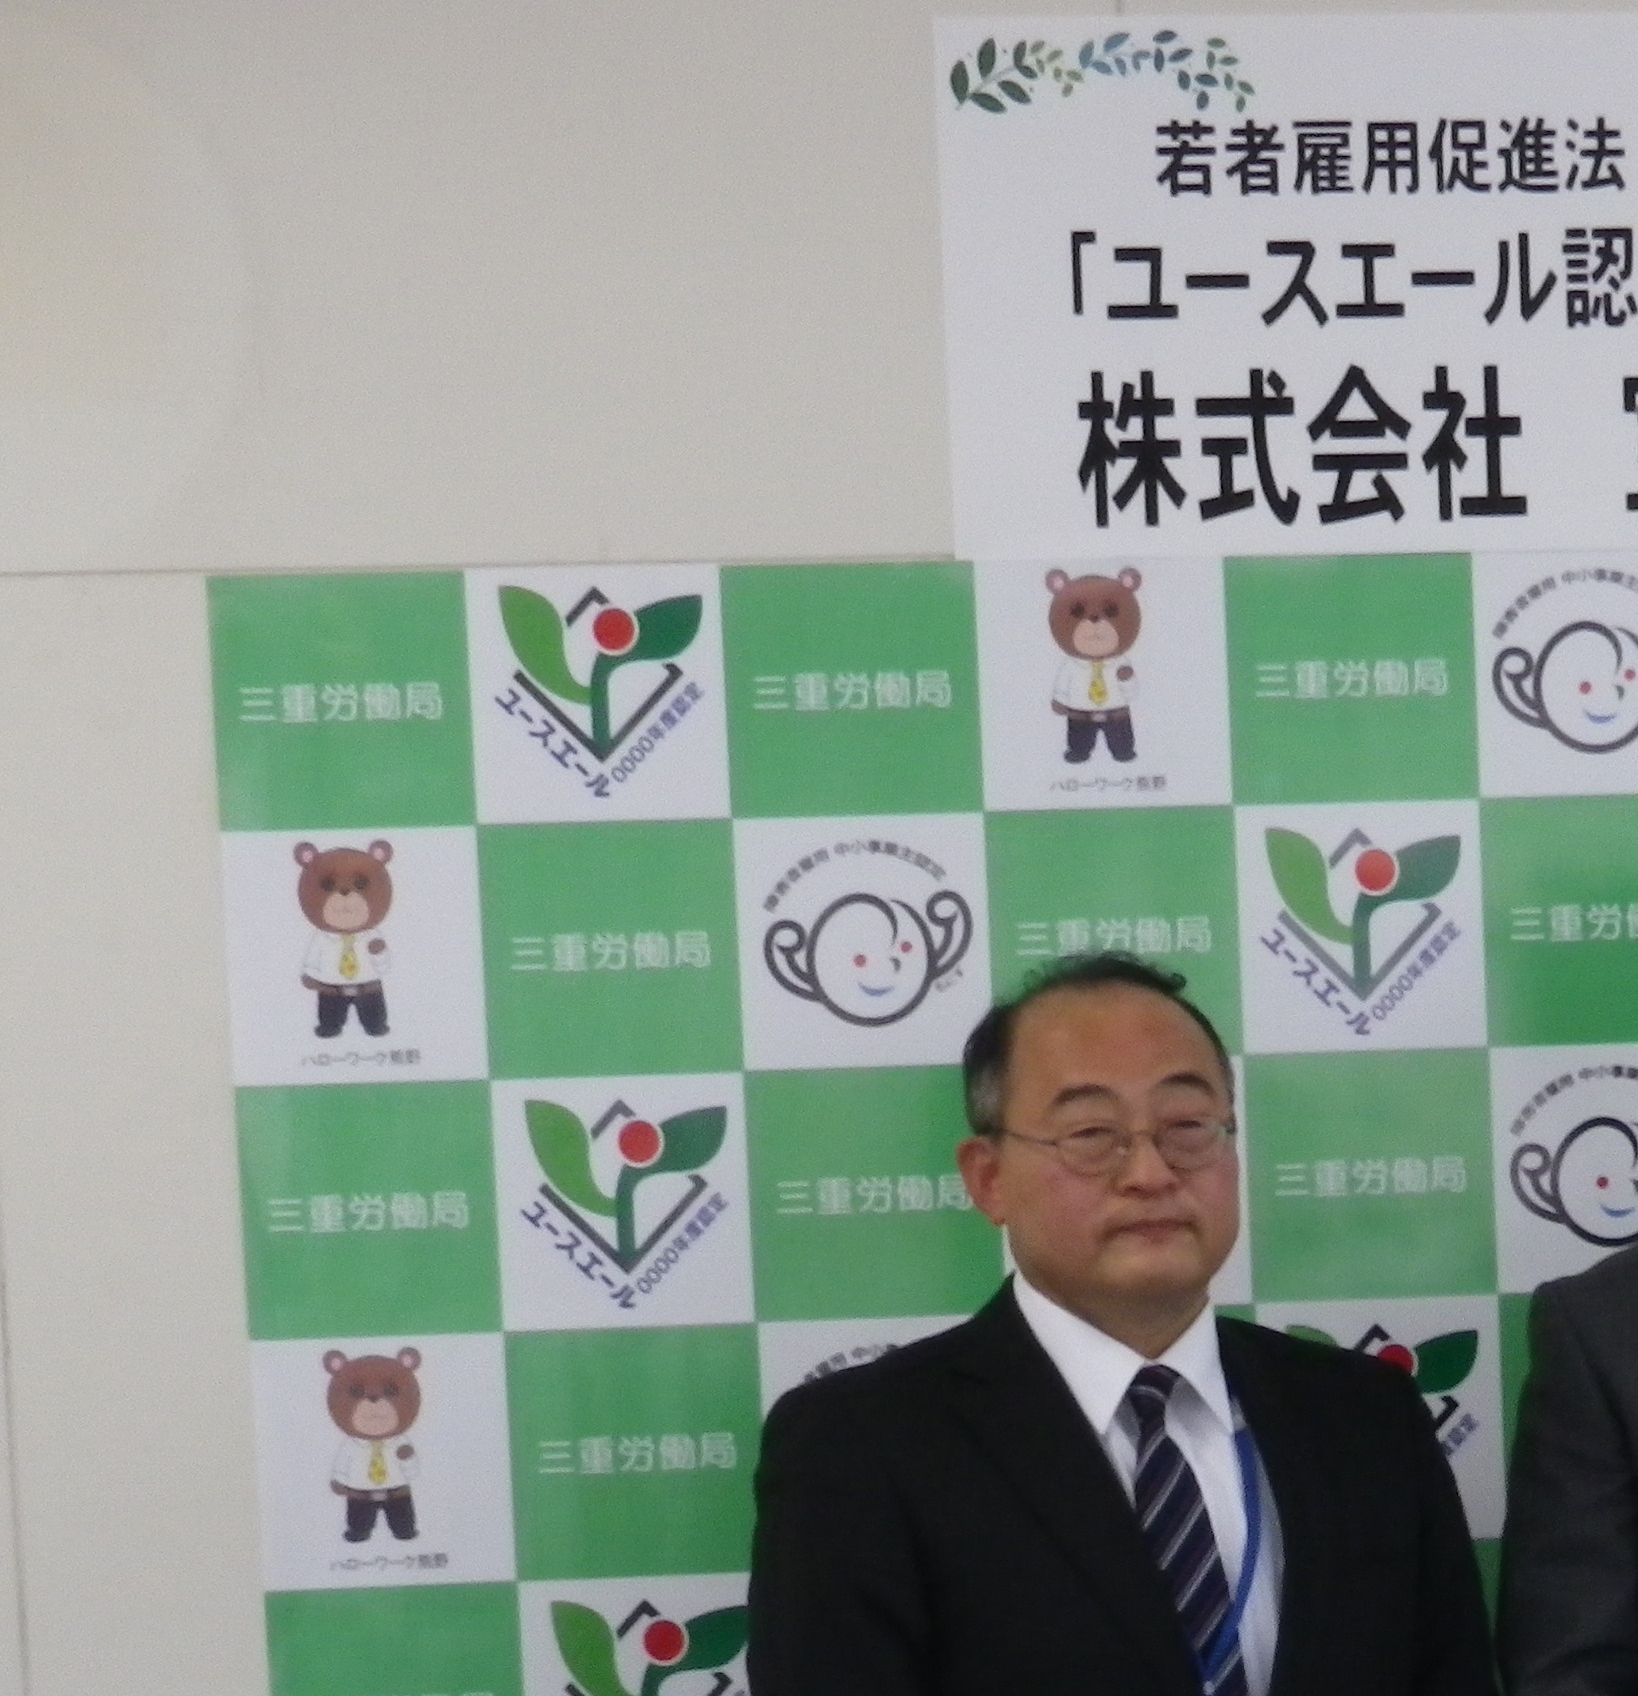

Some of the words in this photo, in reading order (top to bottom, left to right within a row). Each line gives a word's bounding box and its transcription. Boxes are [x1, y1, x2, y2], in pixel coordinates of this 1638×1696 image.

[1155, 115, 1627, 198] 若者雇用促進法
[1078, 362, 1528, 529] 株式会社
[753, 670, 952, 712] 三重労働局
[1256, 658, 1449, 700] 三重労働局
[240, 682, 443, 724] 三重労働局
[495, 688, 610, 798] ユースエール
[511, 931, 711, 973] 三重労働局
[1016, 916, 1213, 957] 三重労働局
[1261, 929, 1370, 1035] ユースエール
[1276, 1156, 1467, 1198] 三重労働局
[269, 1191, 469, 1233] 三重労働局
[520, 1201, 636, 1309] ユースエール
[538, 1432, 737, 1475] 三重労働局
